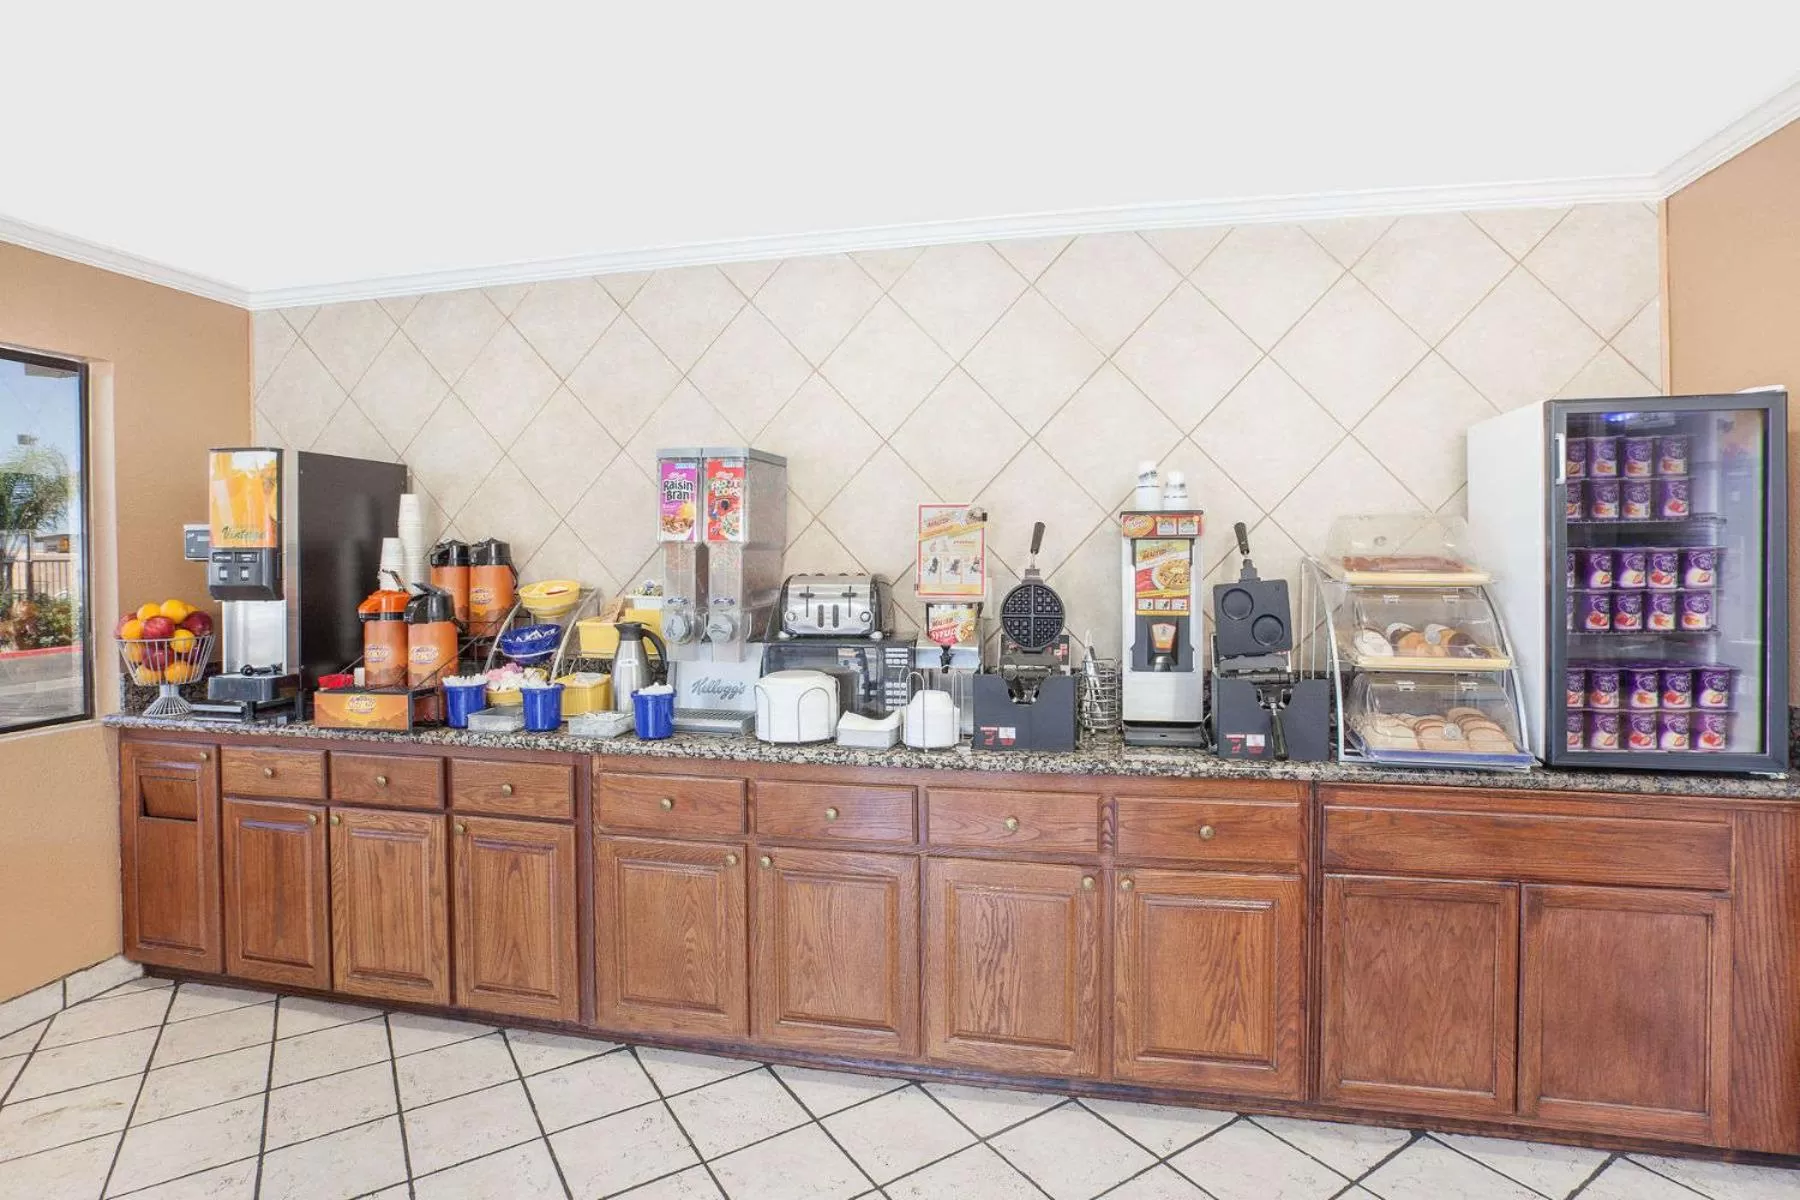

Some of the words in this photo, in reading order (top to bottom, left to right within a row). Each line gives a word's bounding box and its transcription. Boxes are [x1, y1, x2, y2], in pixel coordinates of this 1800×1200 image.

[663, 480, 693, 492] Raisin
[666, 490, 690, 501] Bran
[692, 677, 746, 700] Kellogg's
